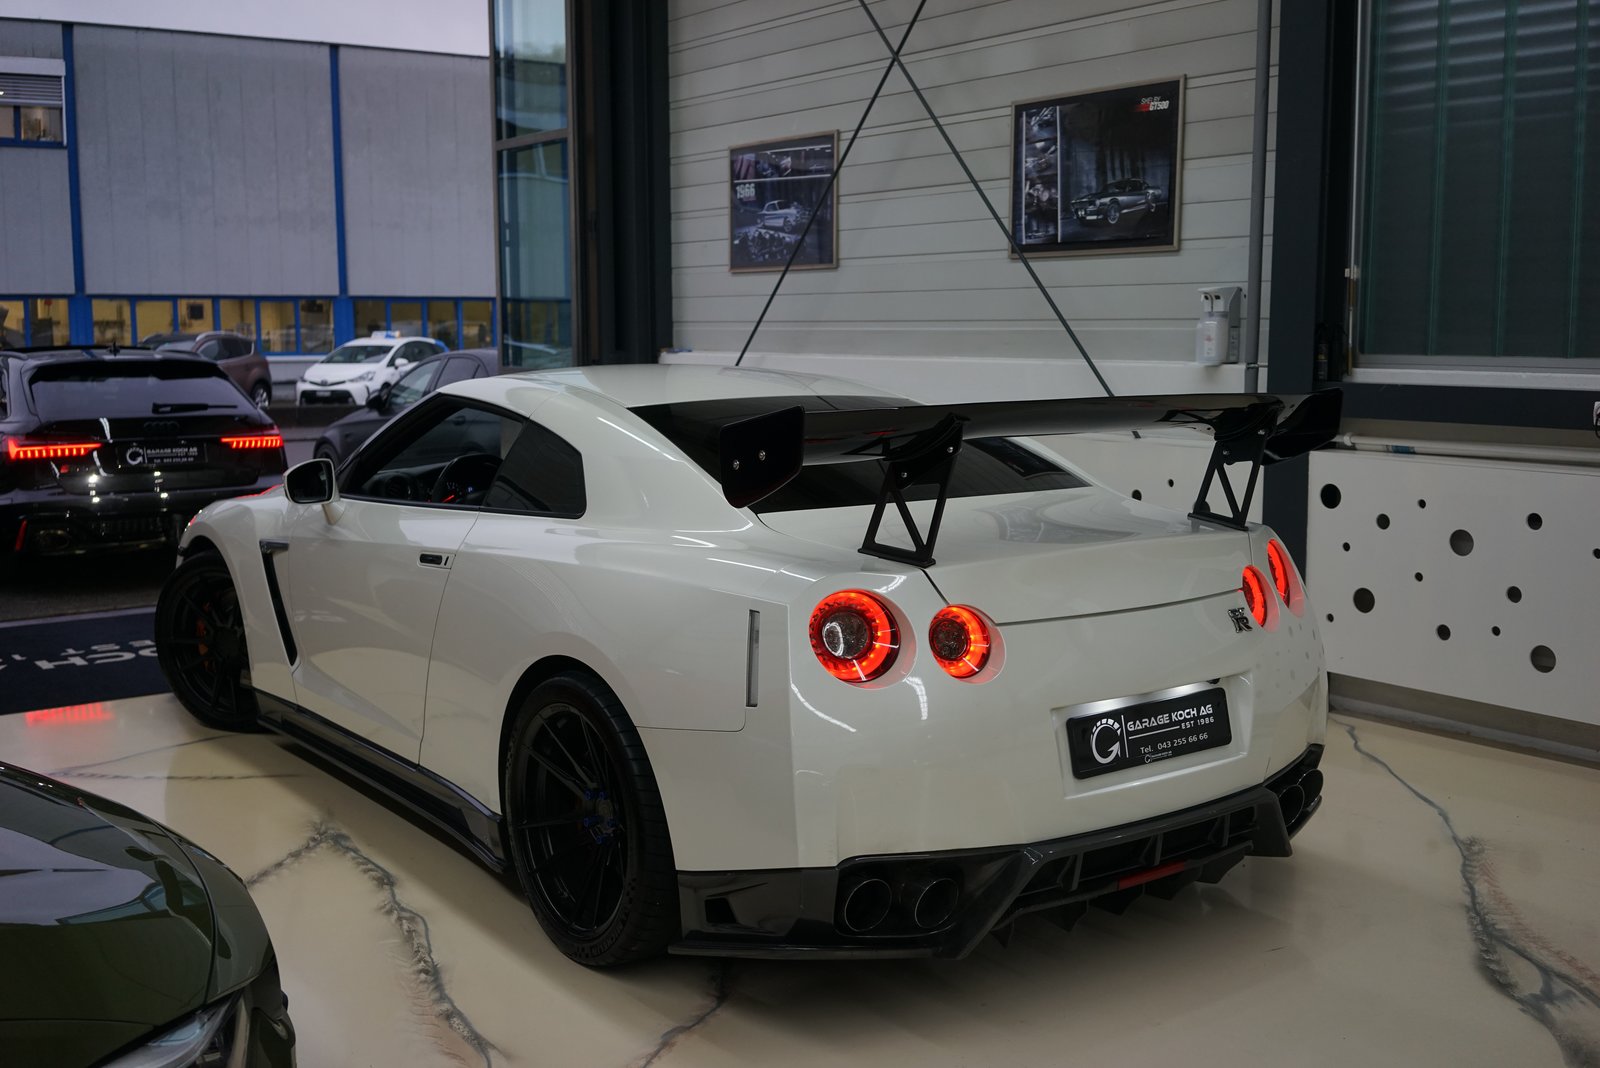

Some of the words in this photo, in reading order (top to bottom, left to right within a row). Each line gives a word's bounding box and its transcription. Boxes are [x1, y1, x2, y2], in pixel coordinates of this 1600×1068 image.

[1149, 100, 1169, 111] GT500
[736, 183, 755, 199] 1966
[1127, 714, 1170, 731] GARAGE
[1172, 707, 1197, 722] KOCH
[1199, 704, 1213, 716] AG
[1181, 721, 1195, 730] EST
[1197, 716, 1215, 726] 1986
[1140, 746, 1154, 755] Tel.
[1157, 740, 1172, 750] 043
[1173, 738, 1187, 747] 255
[1188, 735, 1198, 743] 66
[1199, 732, 1209, 740] 66
